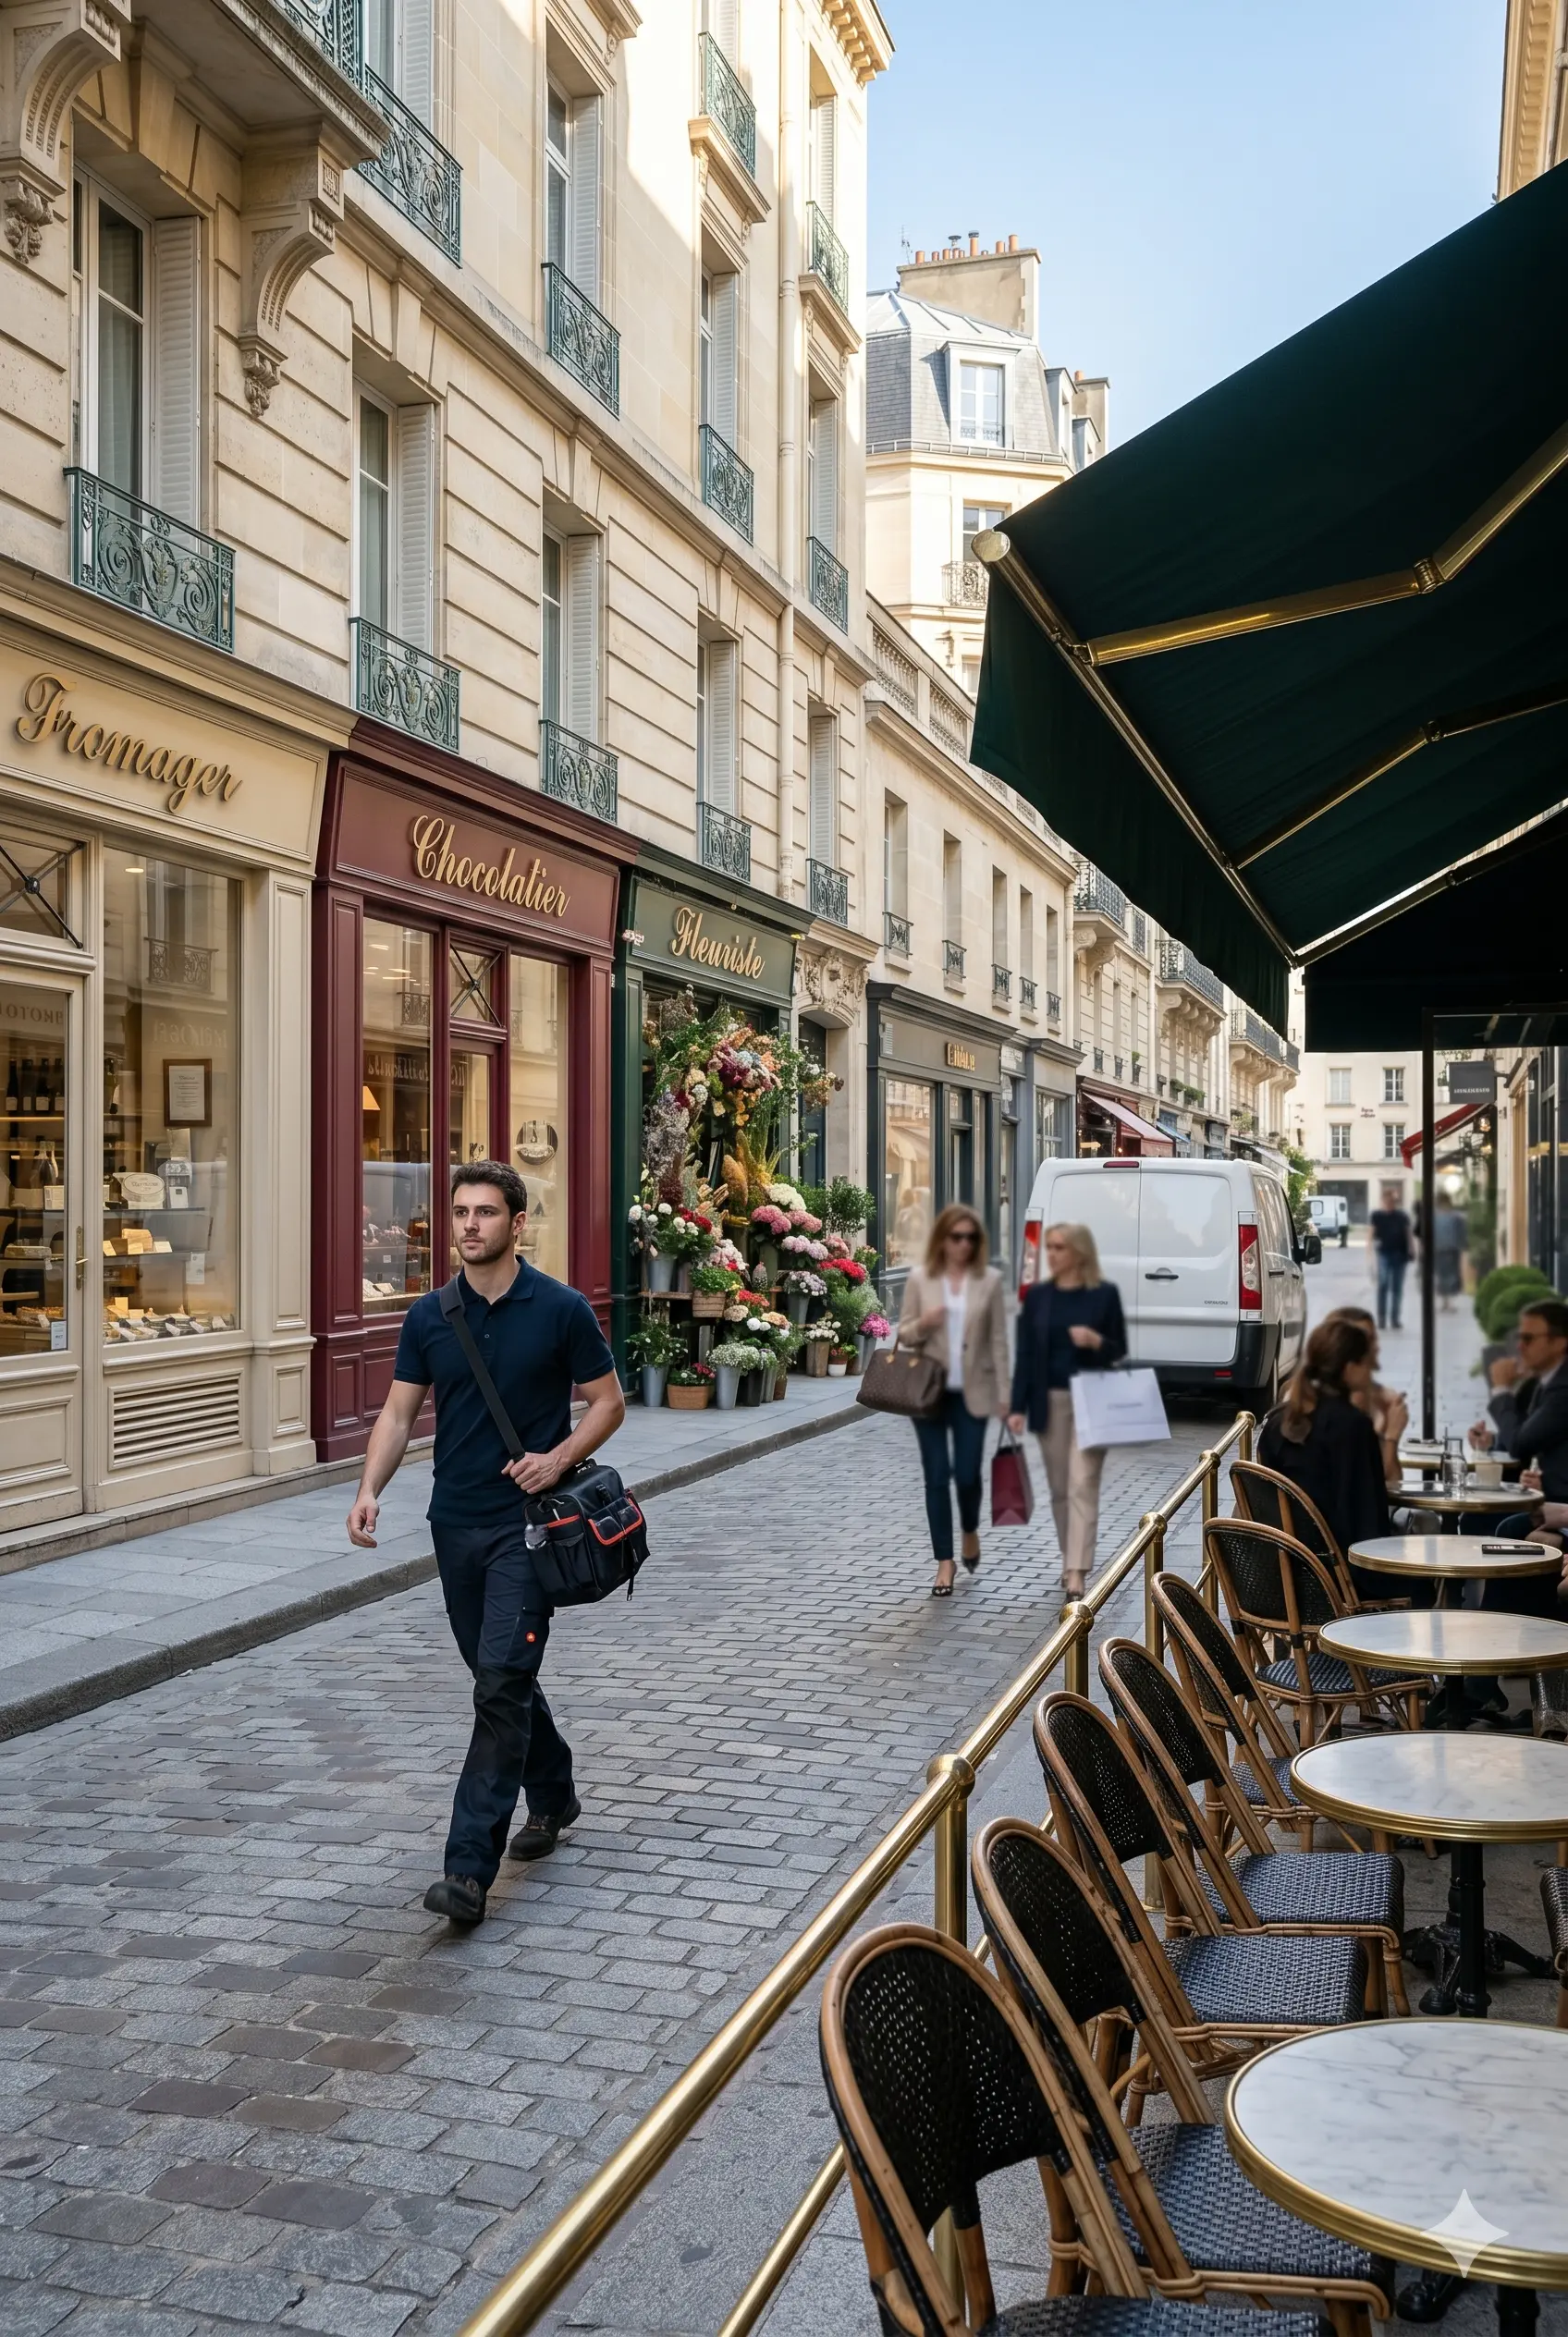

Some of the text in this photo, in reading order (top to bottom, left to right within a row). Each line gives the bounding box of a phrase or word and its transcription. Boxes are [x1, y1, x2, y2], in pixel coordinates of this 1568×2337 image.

[17, 672, 243, 814] Fromager
[412, 814, 570, 917] Chocolatier
[672, 907, 766, 980] Fleuriste
